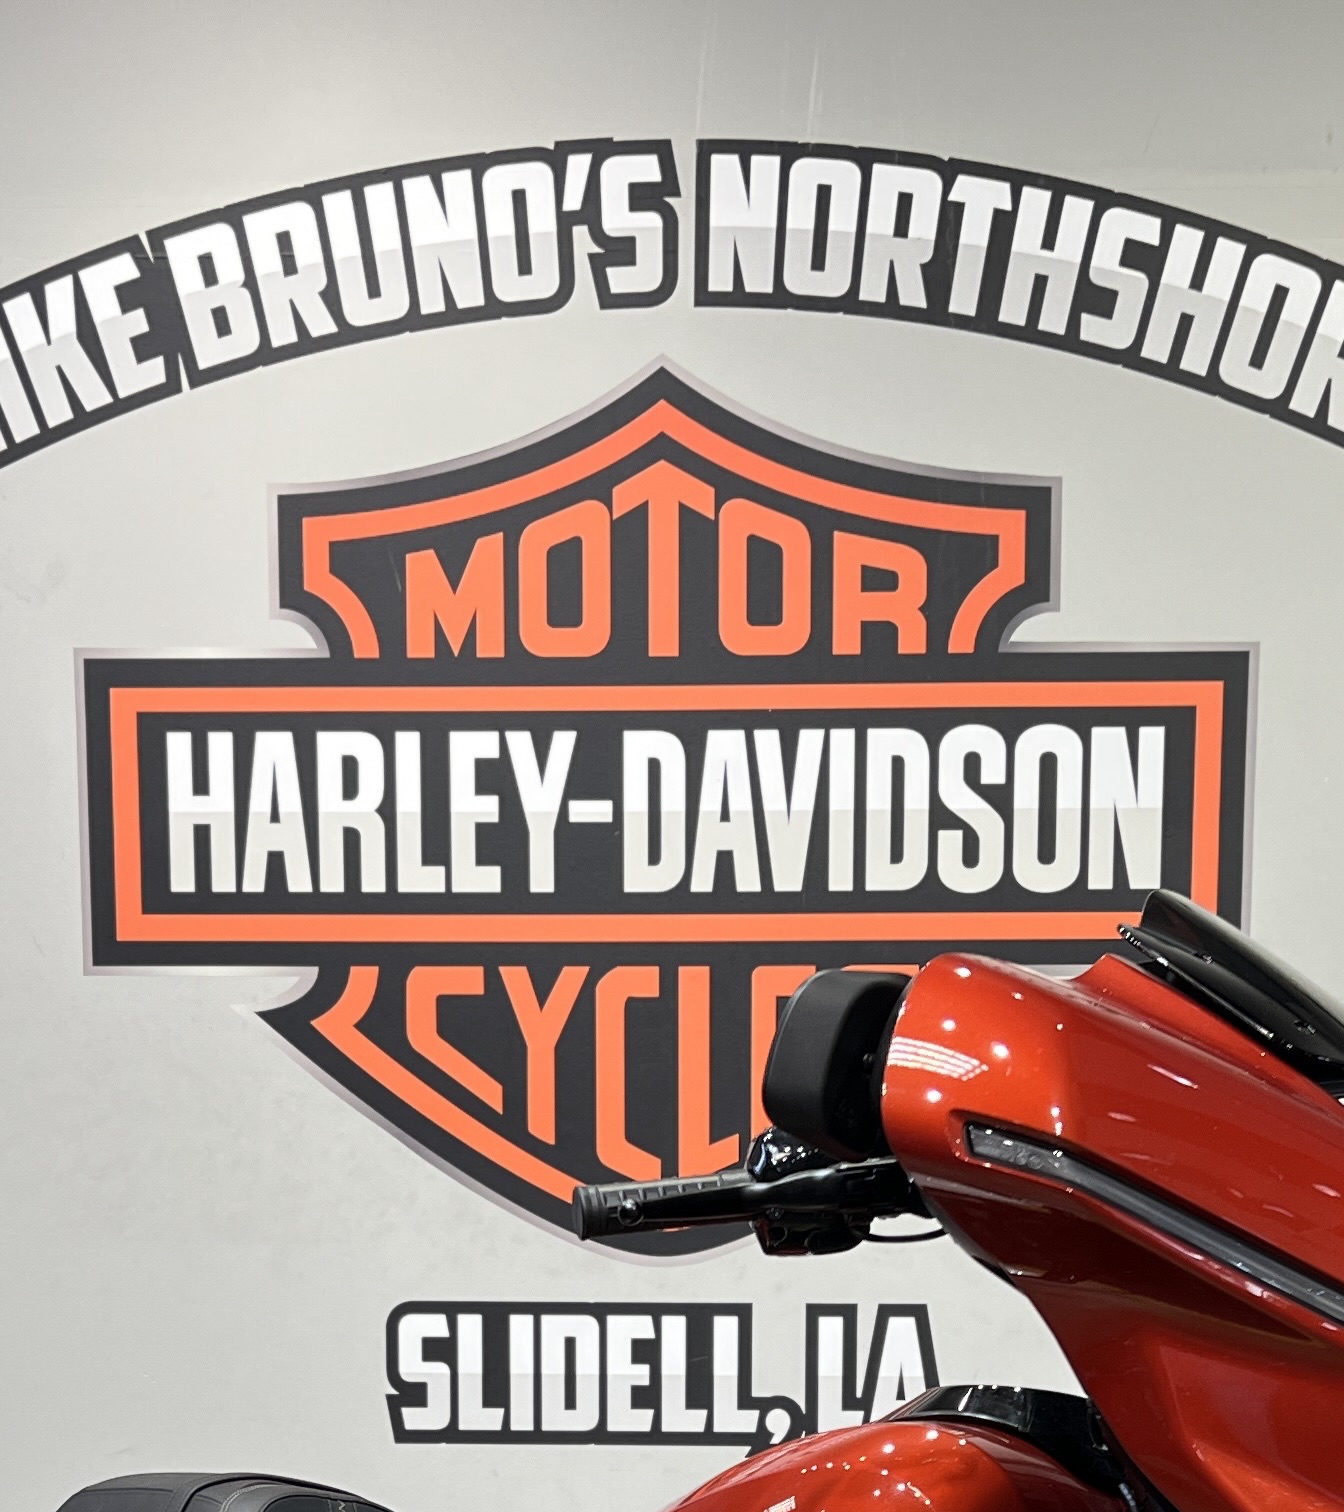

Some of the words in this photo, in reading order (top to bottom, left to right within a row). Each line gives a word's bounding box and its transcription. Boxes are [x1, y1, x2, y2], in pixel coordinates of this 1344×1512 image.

[163, 152, 666, 370] BRUNO'S
[405, 459, 928, 659] MOTOR
[165, 722, 1167, 895] HARLEY-DAVIDSON
[405, 964, 920, 1183] CYCL
[396, 1312, 793, 1446] SLIDELL,
[816, 1314, 931, 1433] LA
